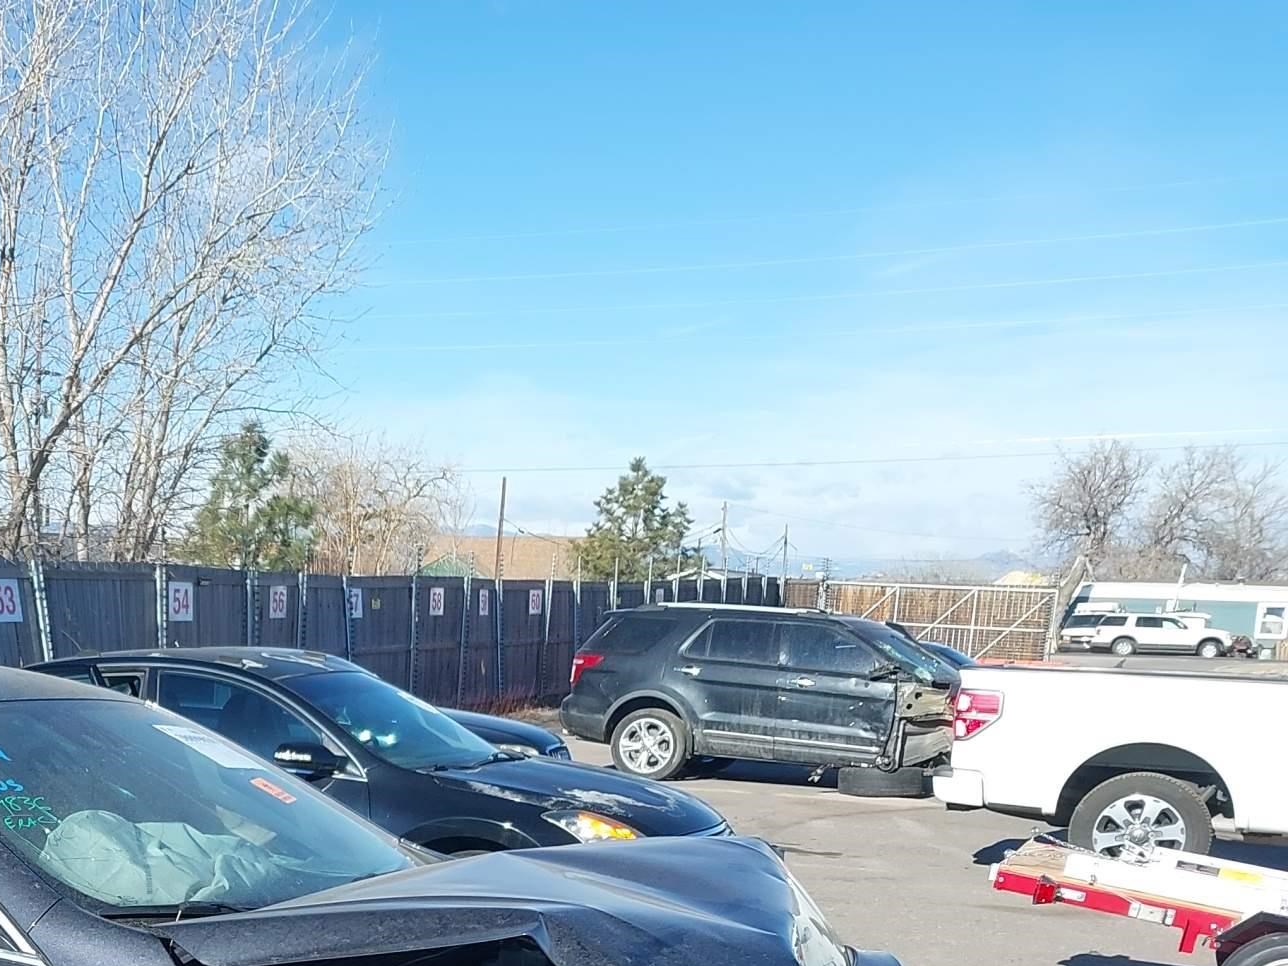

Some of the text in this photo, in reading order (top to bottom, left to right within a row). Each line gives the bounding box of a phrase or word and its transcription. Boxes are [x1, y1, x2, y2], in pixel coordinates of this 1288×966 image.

[172, 588, 190, 615] 54
[272, 591, 285, 613] 56
[432, 591, 442, 611] 58
